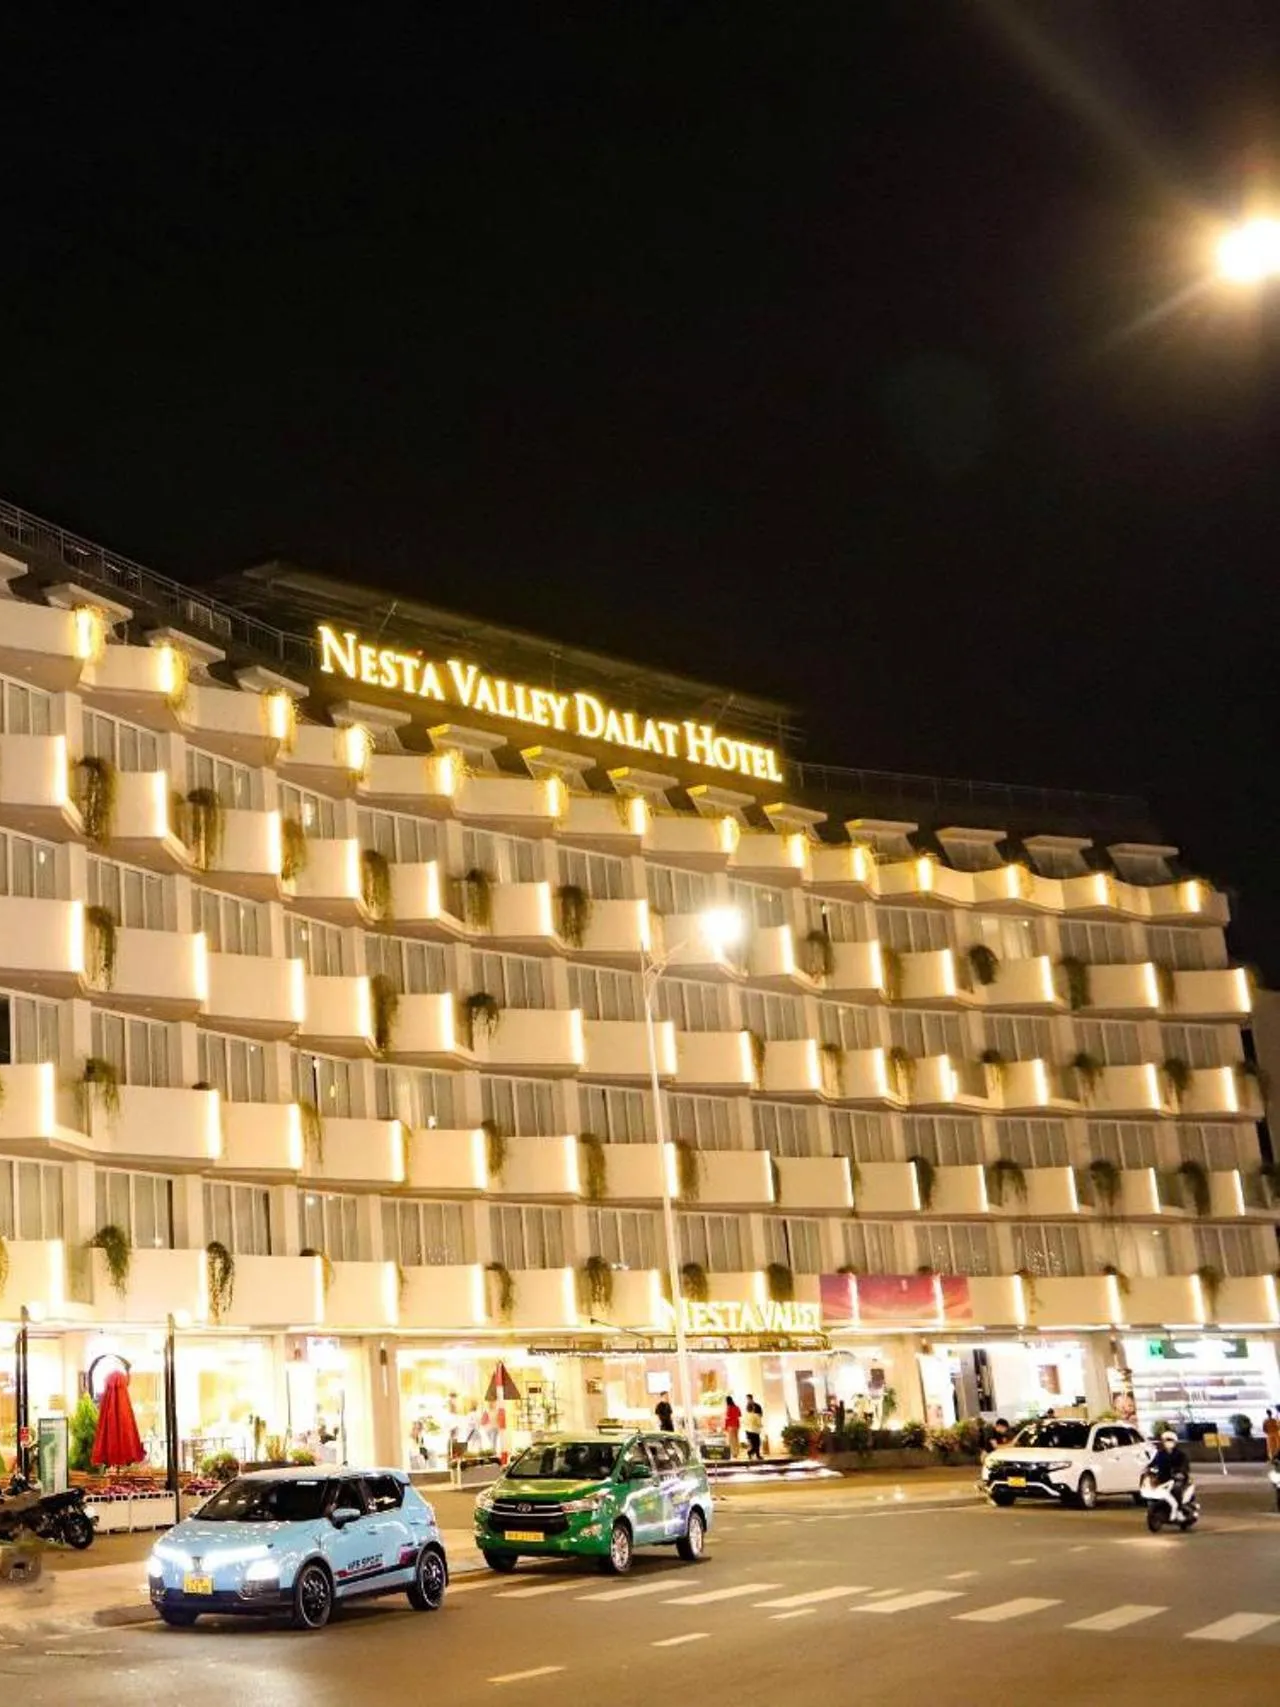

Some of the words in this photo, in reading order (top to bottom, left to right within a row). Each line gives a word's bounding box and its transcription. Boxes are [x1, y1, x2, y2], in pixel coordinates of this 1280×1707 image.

[317, 625, 446, 701] NESTA
[447, 658, 569, 731] VALLEY
[574, 692, 679, 758] DALAT
[683, 720, 783, 783] HOTEL
